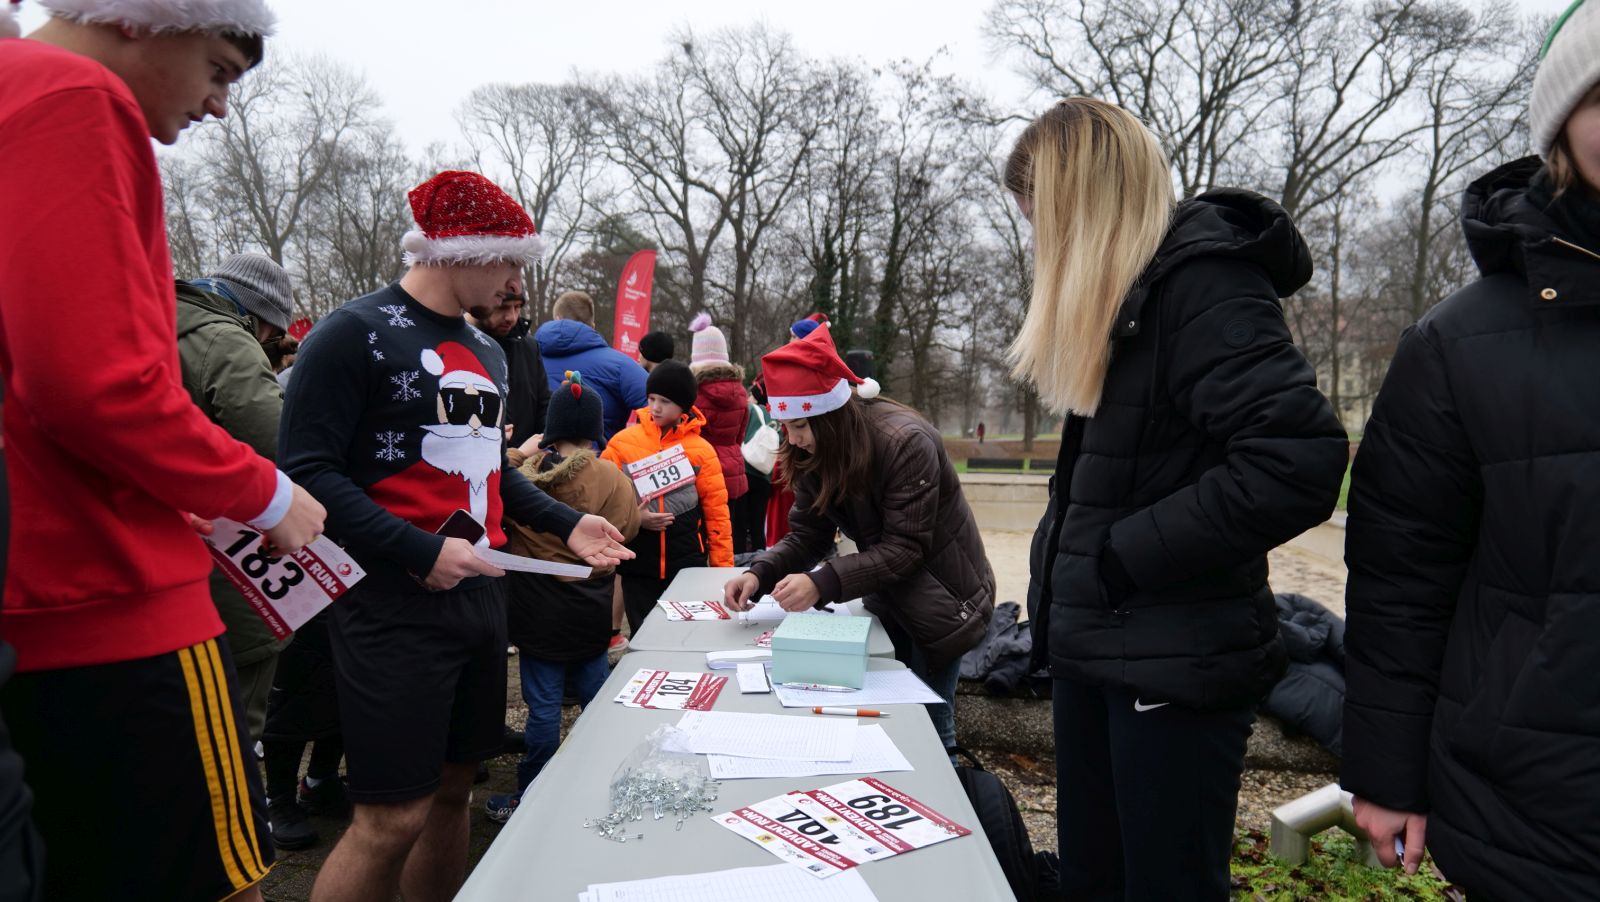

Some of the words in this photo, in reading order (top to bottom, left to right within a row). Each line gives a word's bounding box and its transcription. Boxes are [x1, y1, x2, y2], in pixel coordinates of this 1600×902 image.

[649, 465, 681, 489] 139
[225, 530, 305, 600] 183
[309, 562, 338, 594] RUN»
[657, 678, 697, 696] 184
[839, 805, 882, 836] «ADVENT
[847, 794, 925, 830] 189
[770, 822, 820, 852] «ADVENT
